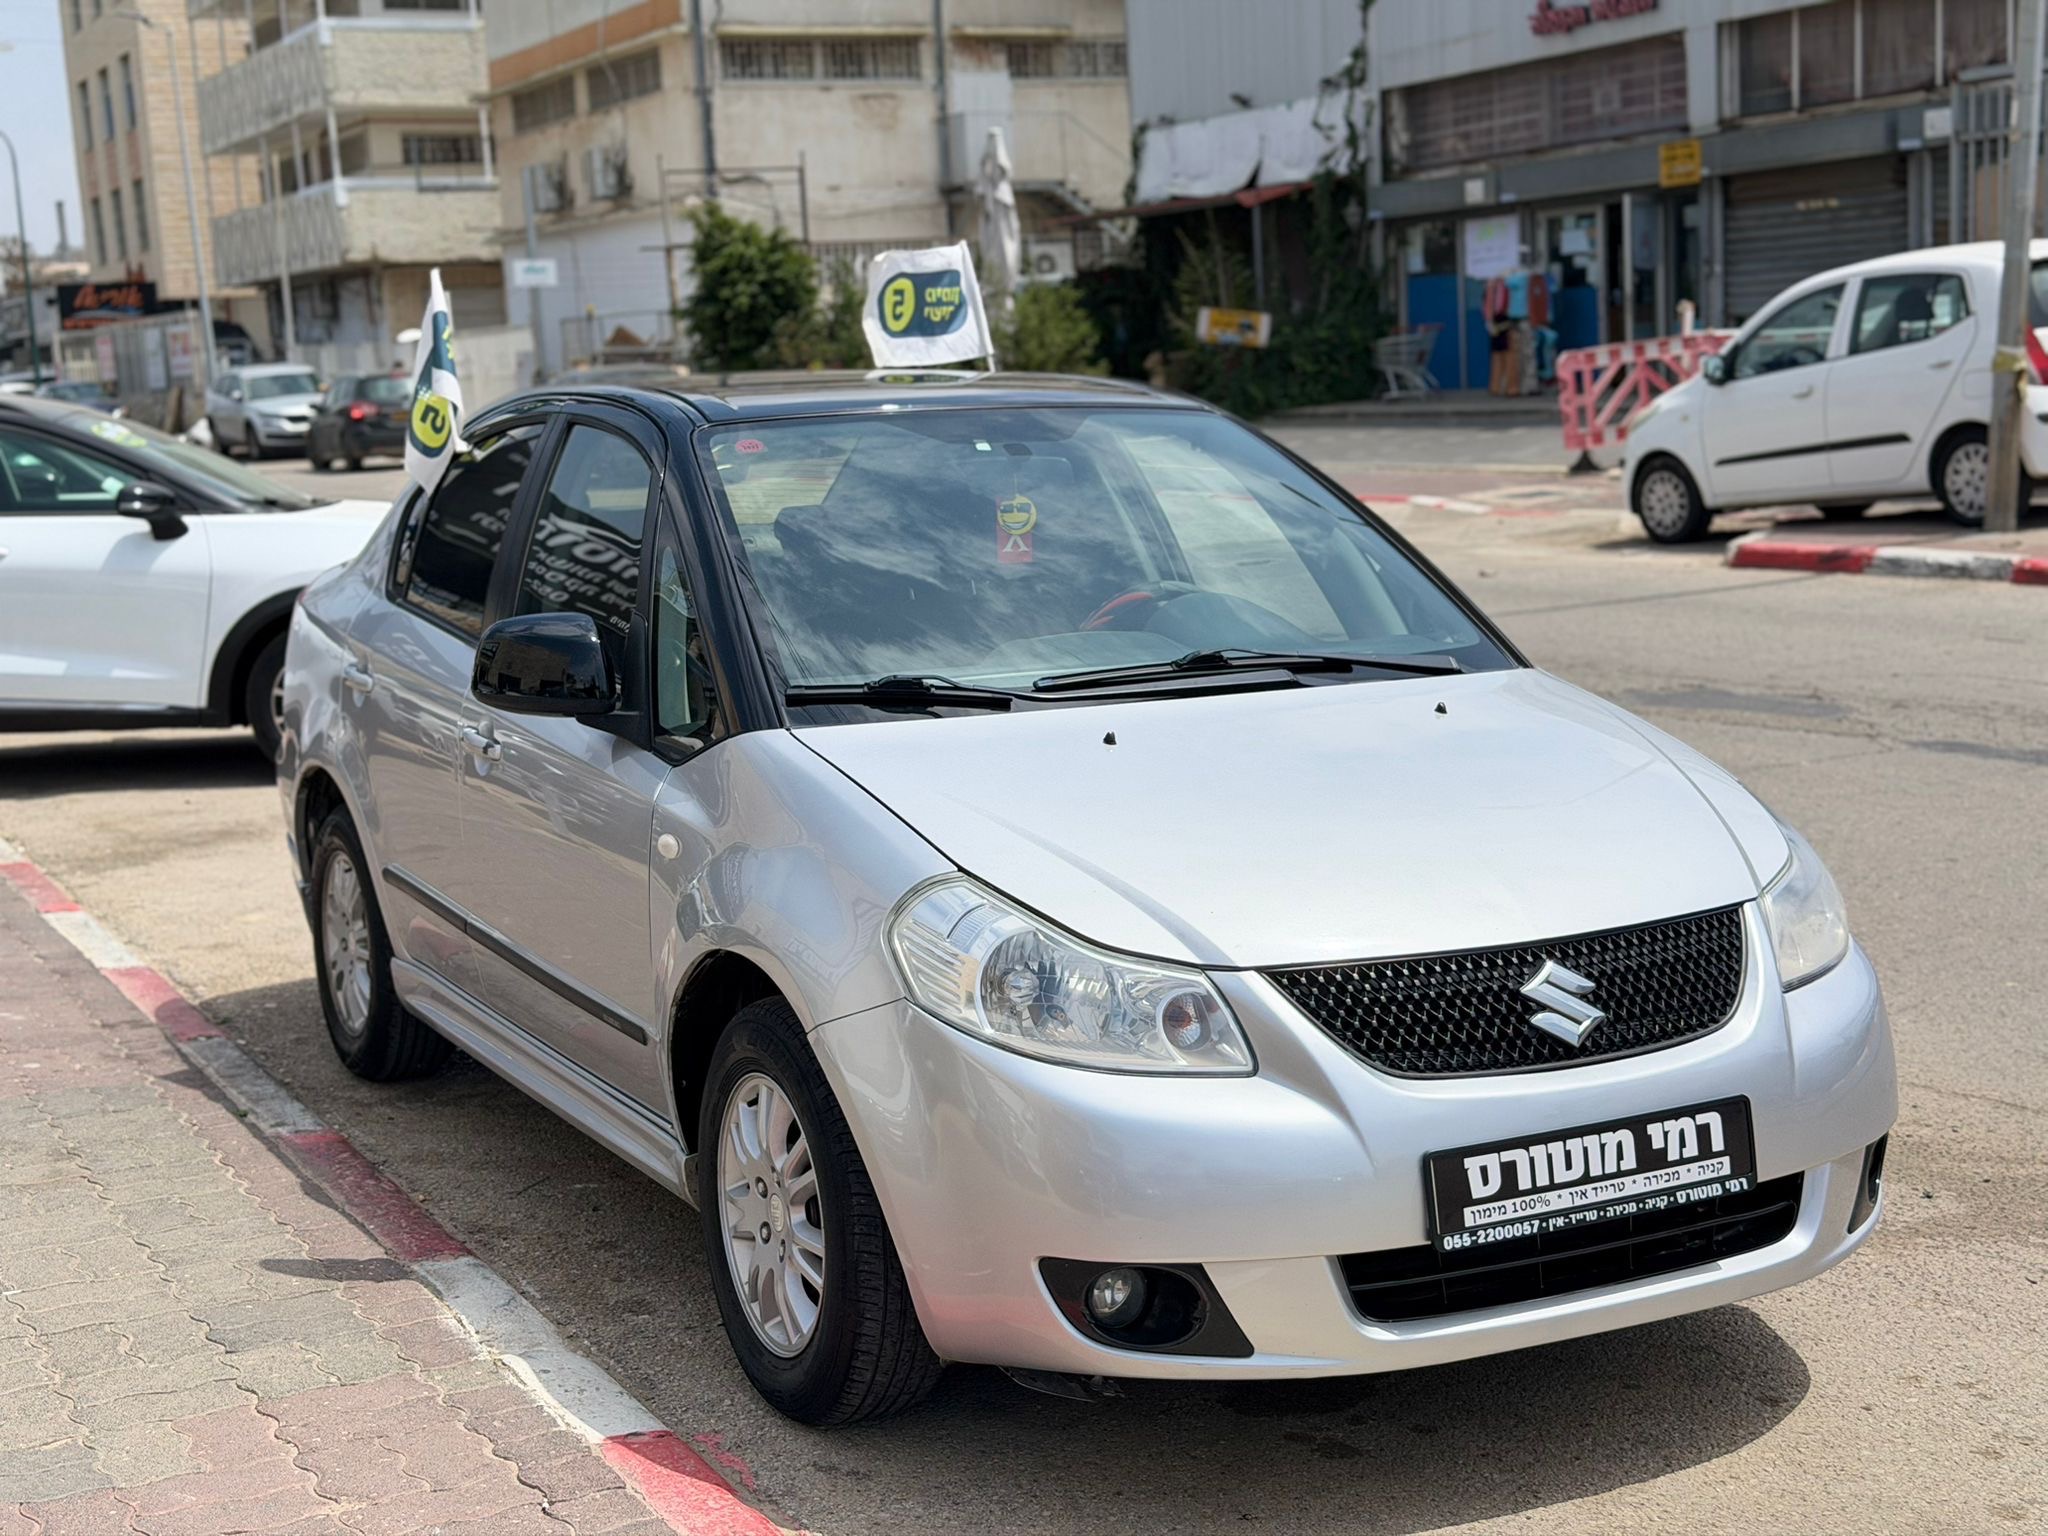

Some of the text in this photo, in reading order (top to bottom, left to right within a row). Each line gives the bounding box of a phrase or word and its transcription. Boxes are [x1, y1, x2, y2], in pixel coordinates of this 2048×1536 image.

[1463, 1111, 1725, 1200] רמי מוטורס
[1470, 1160, 1725, 1224] קניה מכירה טרייד אין 100% מימון
[1675, 1182, 1723, 1204] מוטורס
[1725, 1177, 1749, 1193] רמי
[1605, 1201, 1637, 1218] מכירה
[1644, 1194, 1669, 1210] קניה
[1443, 1219, 1540, 1250] 055-2200057
